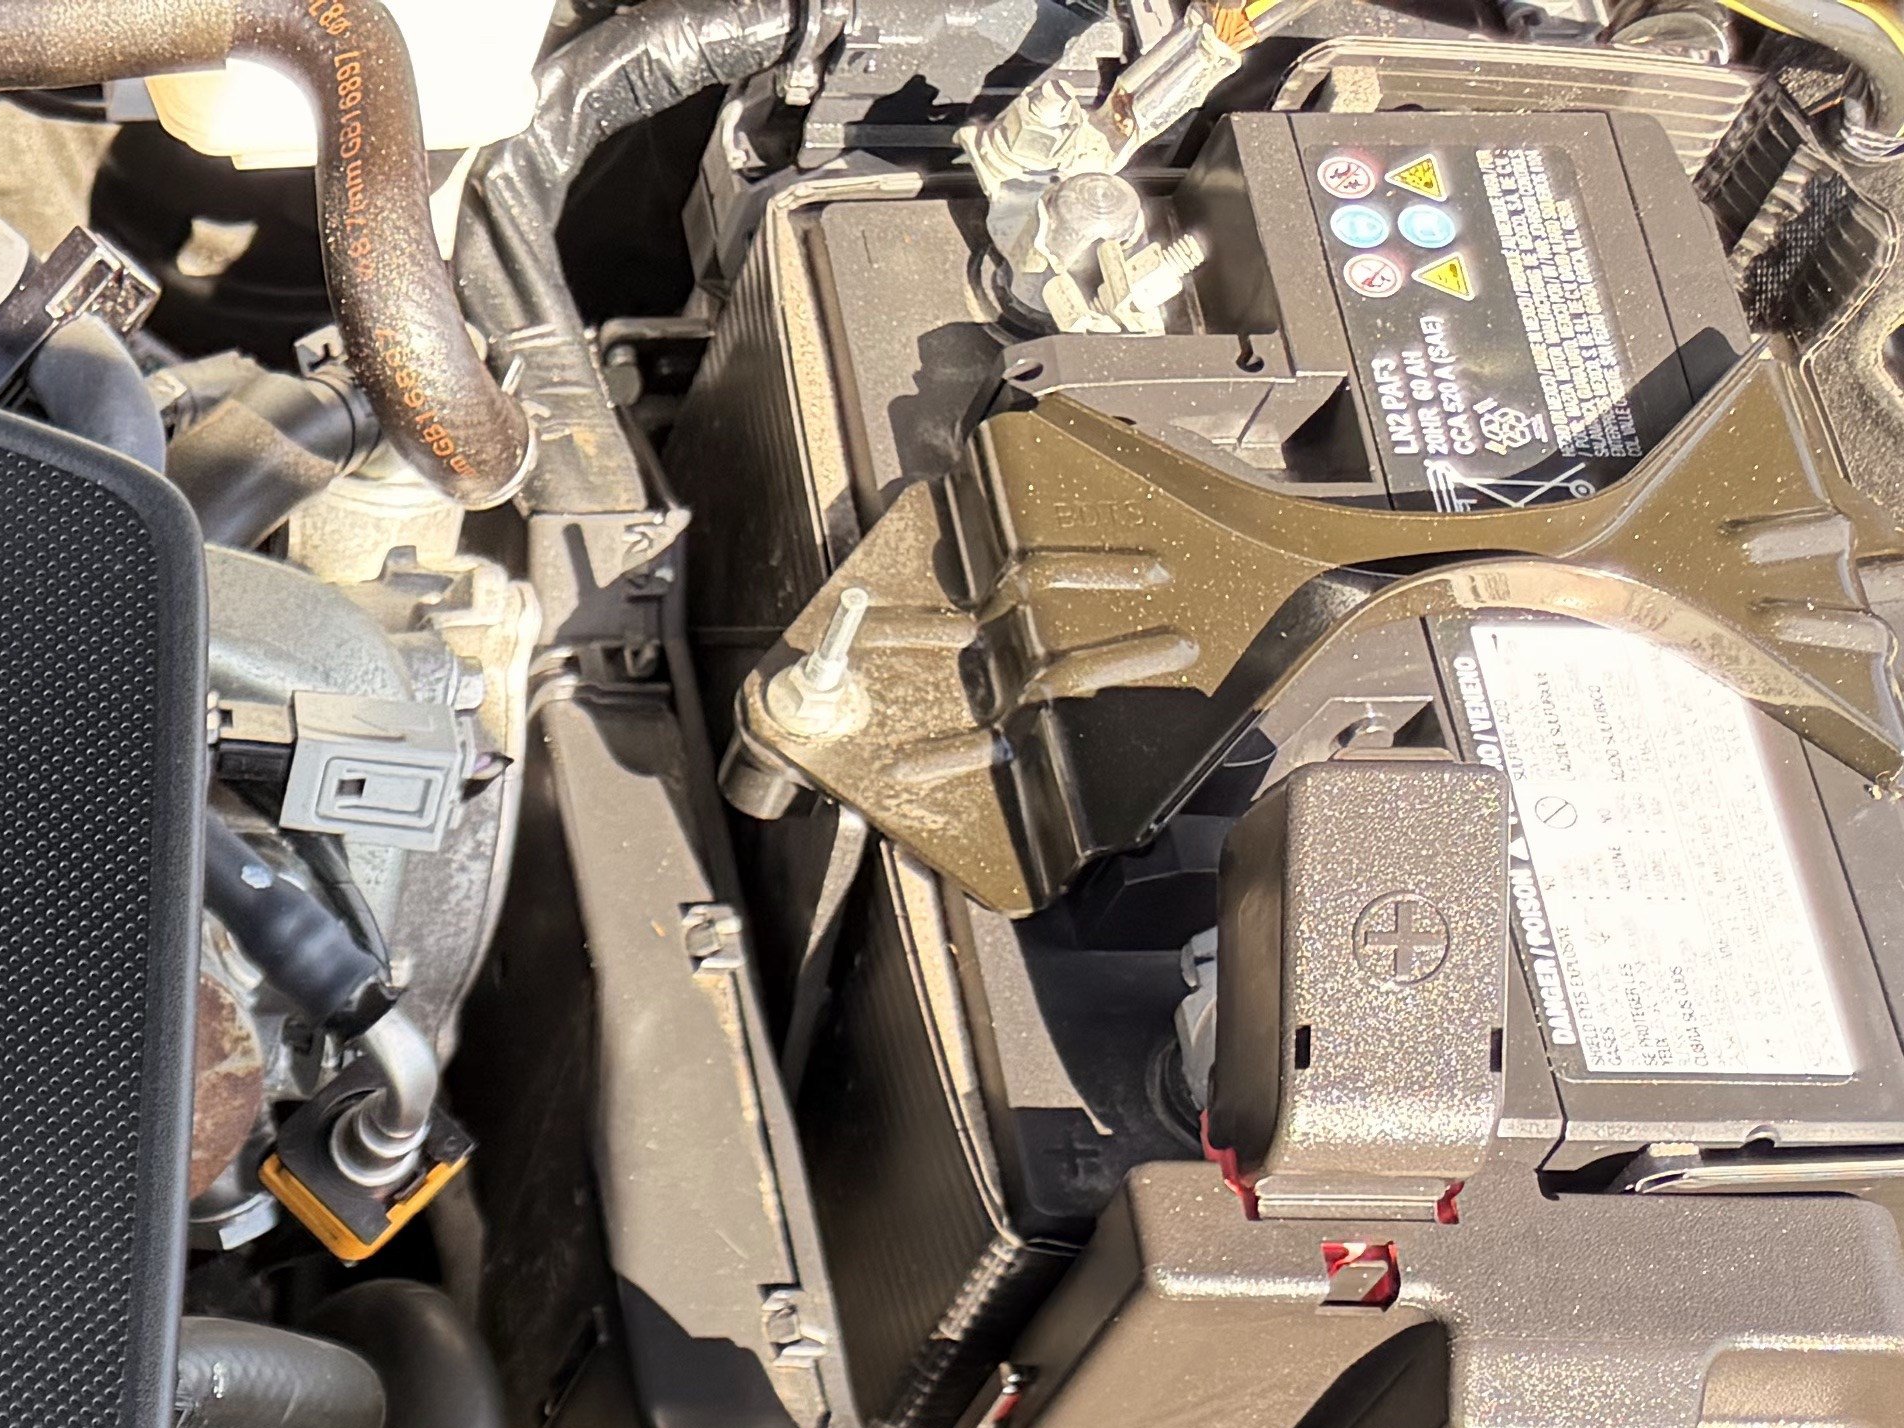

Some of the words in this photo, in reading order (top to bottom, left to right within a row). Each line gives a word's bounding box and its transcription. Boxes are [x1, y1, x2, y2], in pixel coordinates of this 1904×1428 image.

[334, 50, 362, 158] GB16897
[1421, 316, 1455, 366] (SAE)
[1404, 351, 1428, 379] AH
[1433, 367, 1456, 384] A
[1410, 379, 1436, 401] 60
[1440, 383, 1465, 413] 520
[1387, 413, 1416, 454] LN2
[1419, 408, 1447, 456] 20HR
[1448, 415, 1477, 456] CCA
